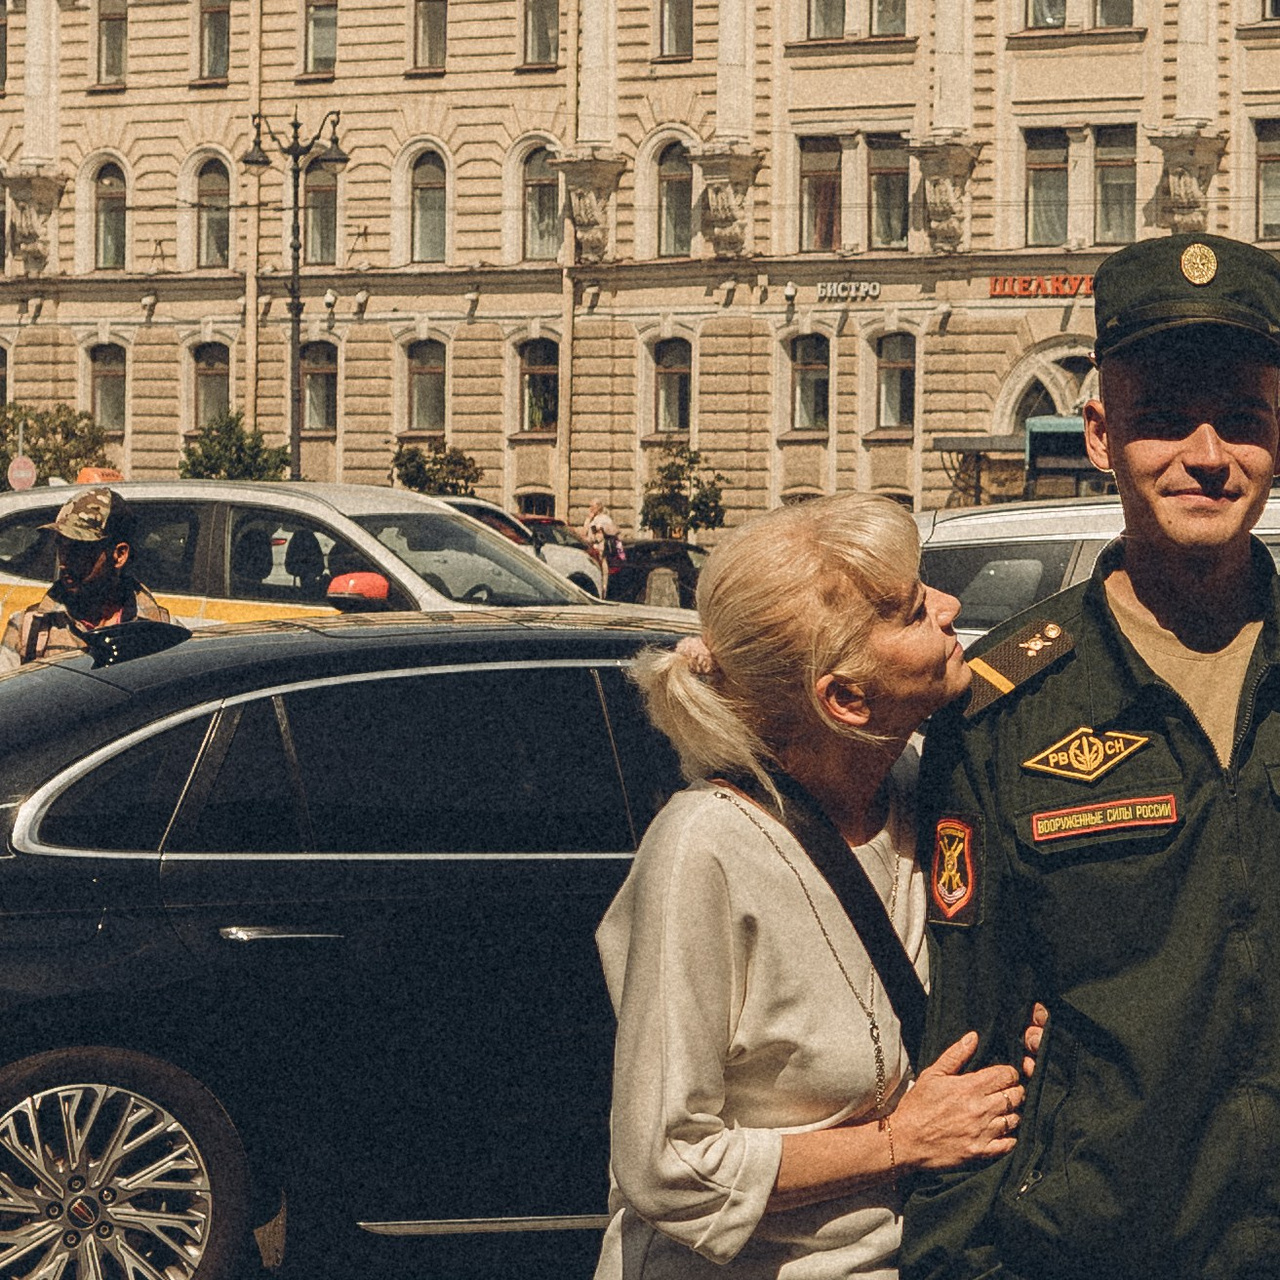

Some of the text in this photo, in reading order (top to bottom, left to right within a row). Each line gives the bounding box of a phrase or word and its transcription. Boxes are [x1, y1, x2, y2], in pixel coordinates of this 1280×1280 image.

[816, 281, 881, 298] БИСТРО
[1048, 738, 1125, 767] РВ СН
[1037, 802, 1172, 834] ВООРУЖЕННЫЕ СИЛЫ РОССИИ
